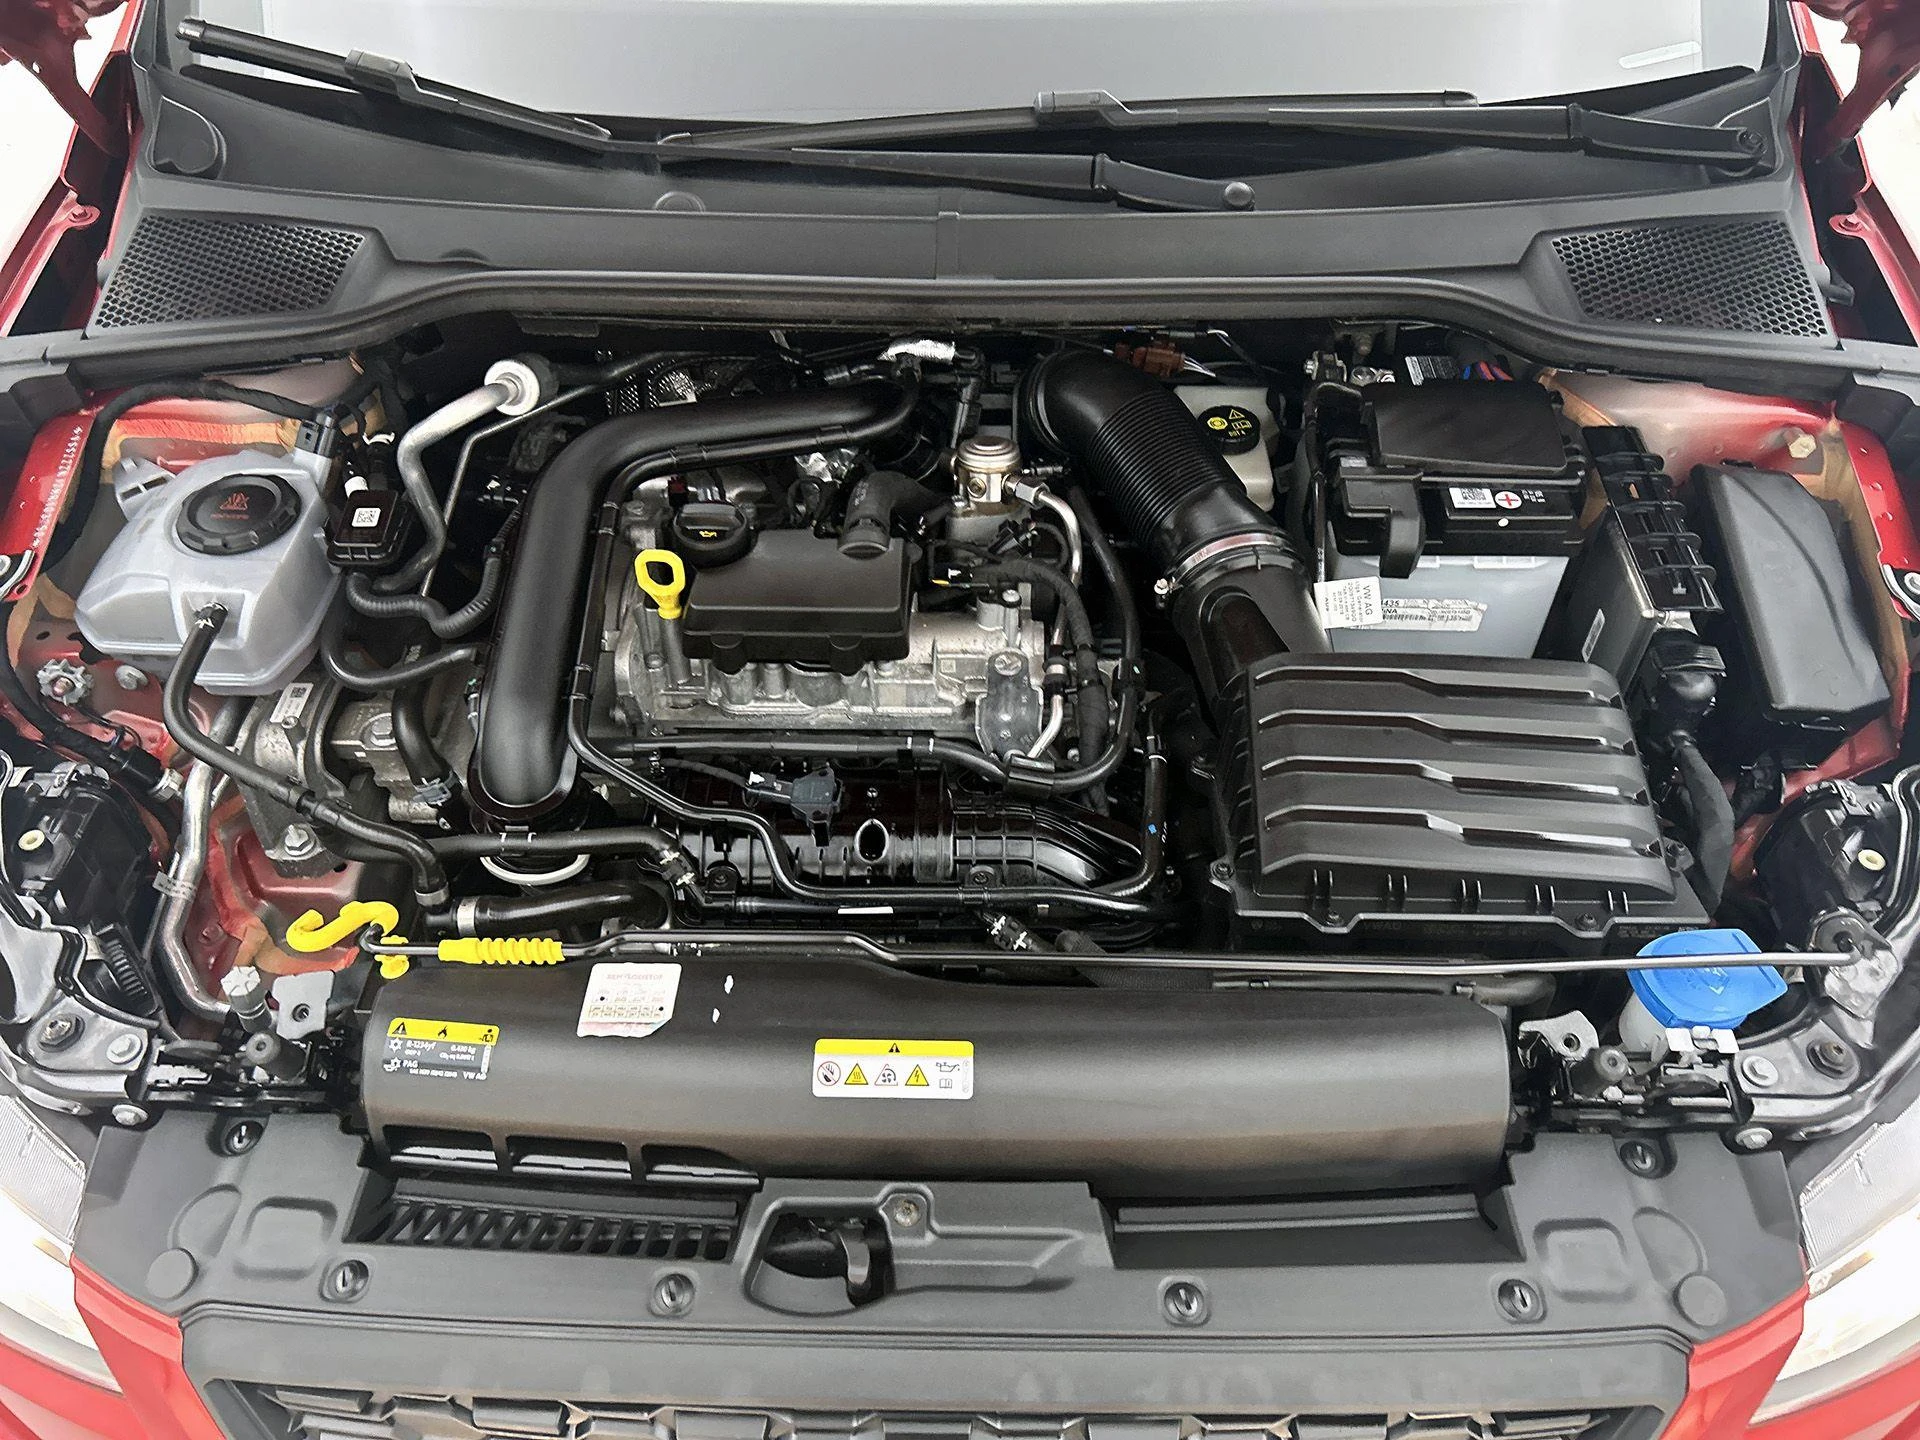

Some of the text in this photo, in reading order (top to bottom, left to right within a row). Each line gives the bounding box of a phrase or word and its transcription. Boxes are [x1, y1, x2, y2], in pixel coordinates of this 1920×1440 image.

[1363, 585, 1374, 616] VW AG
[402, 1059, 419, 1068] PAG
[462, 1071, 476, 1079] VW
